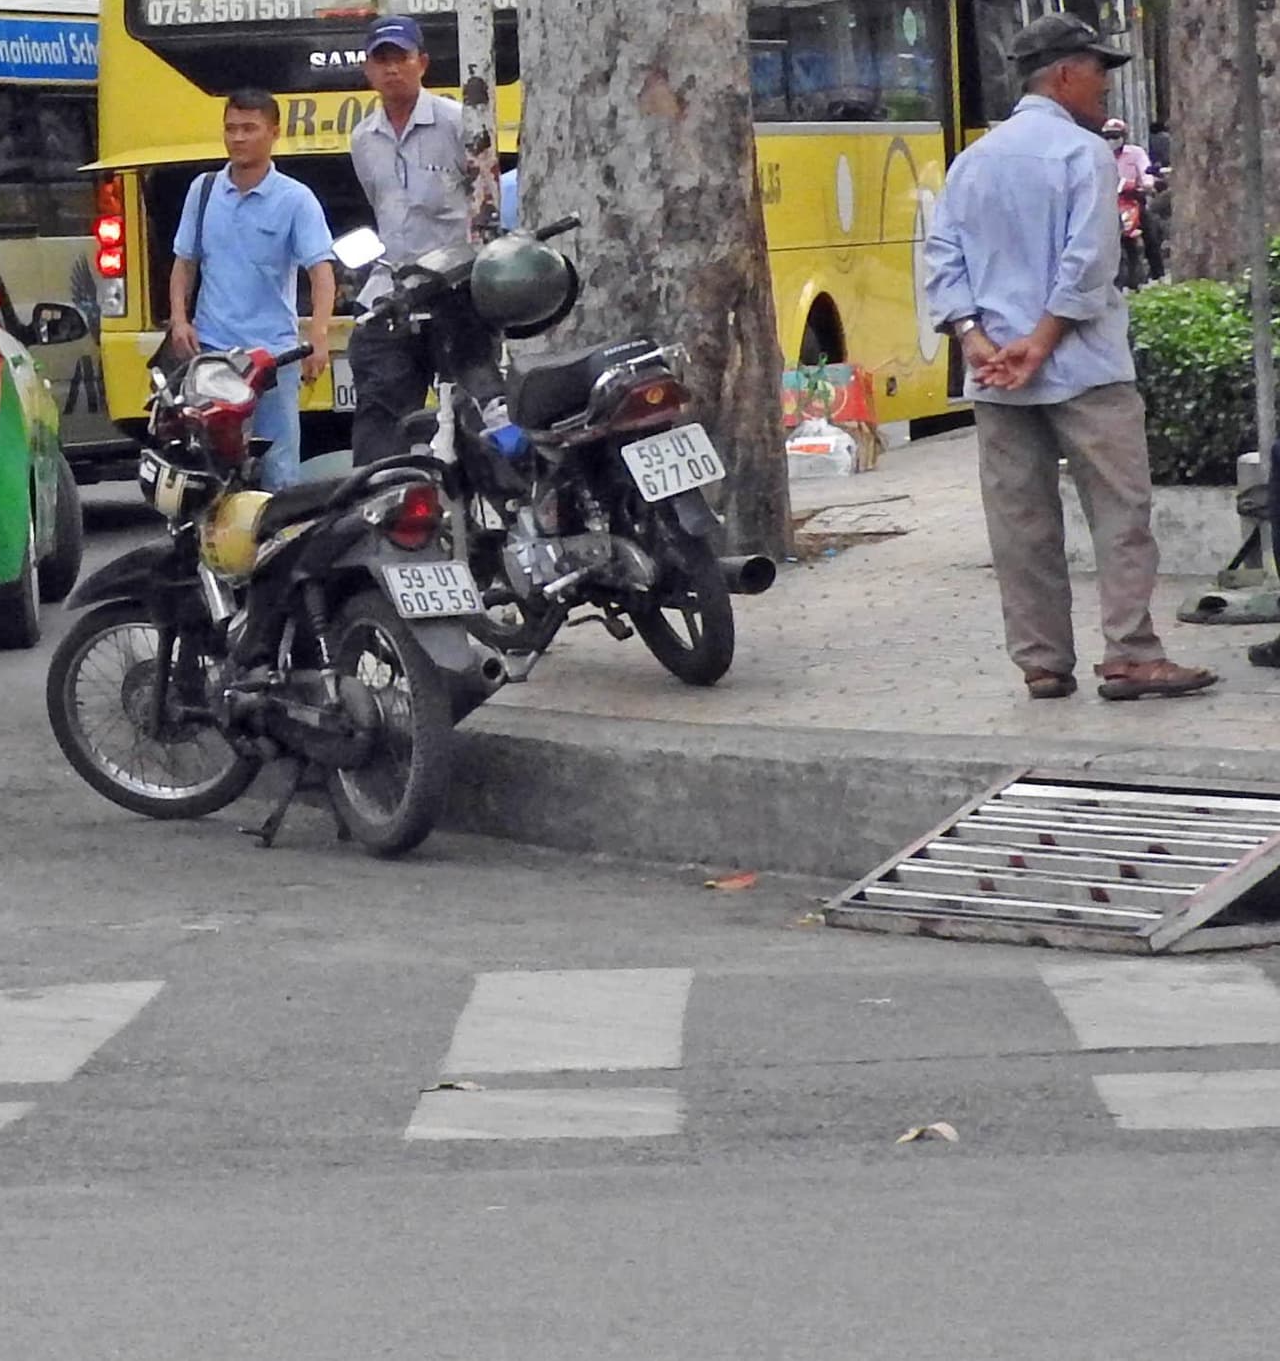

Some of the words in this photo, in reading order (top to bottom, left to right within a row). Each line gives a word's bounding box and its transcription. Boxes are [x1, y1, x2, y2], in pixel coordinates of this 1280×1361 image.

[69, 31, 100, 65] Sch
[636, 432, 697, 470] 59-U1
[642, 453, 717, 496] 677.00
[398, 566, 459, 590] 59-U1
